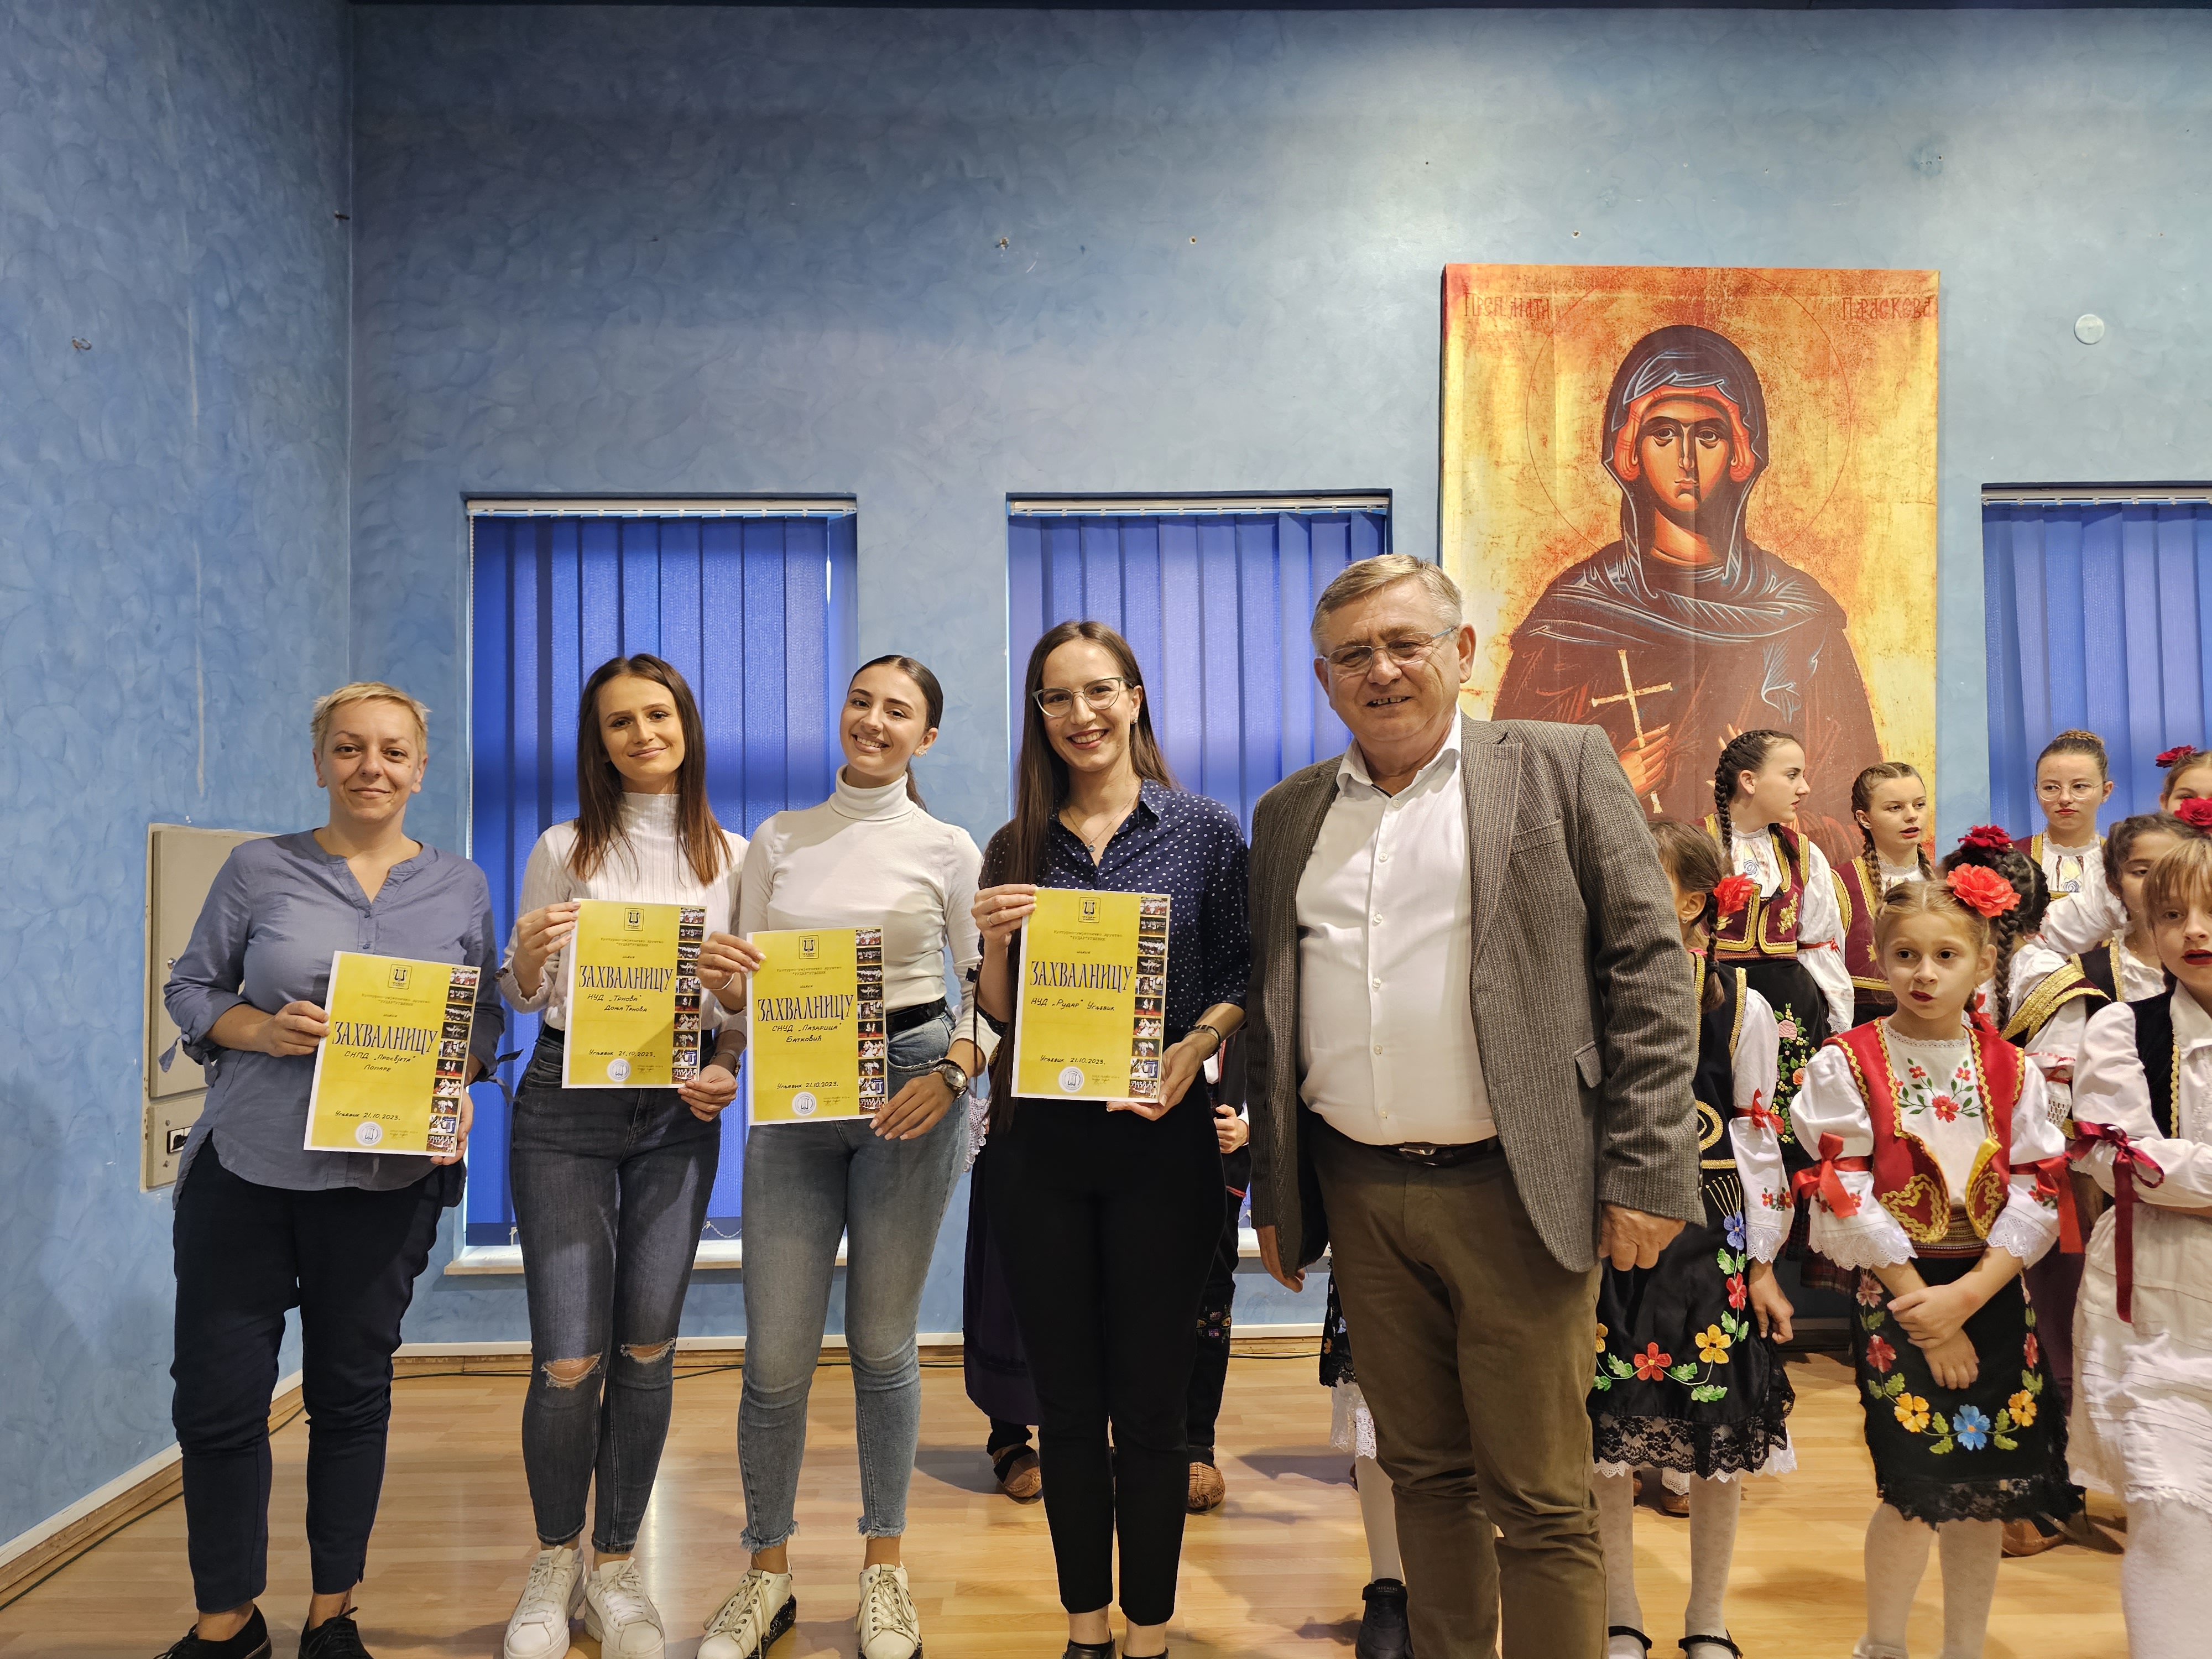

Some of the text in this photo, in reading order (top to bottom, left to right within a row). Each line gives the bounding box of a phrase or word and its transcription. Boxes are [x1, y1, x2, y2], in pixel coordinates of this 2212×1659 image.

[579, 966, 674, 993] ЗАХВАЛНИЦУ
[1030, 961, 1133, 993] ЗАХВАЛНИЦУ
[758, 994, 854, 1021] ЗАХВАЛНИЦУ
[332, 1021, 439, 1055] ЗАХВАЛНИЦУ
